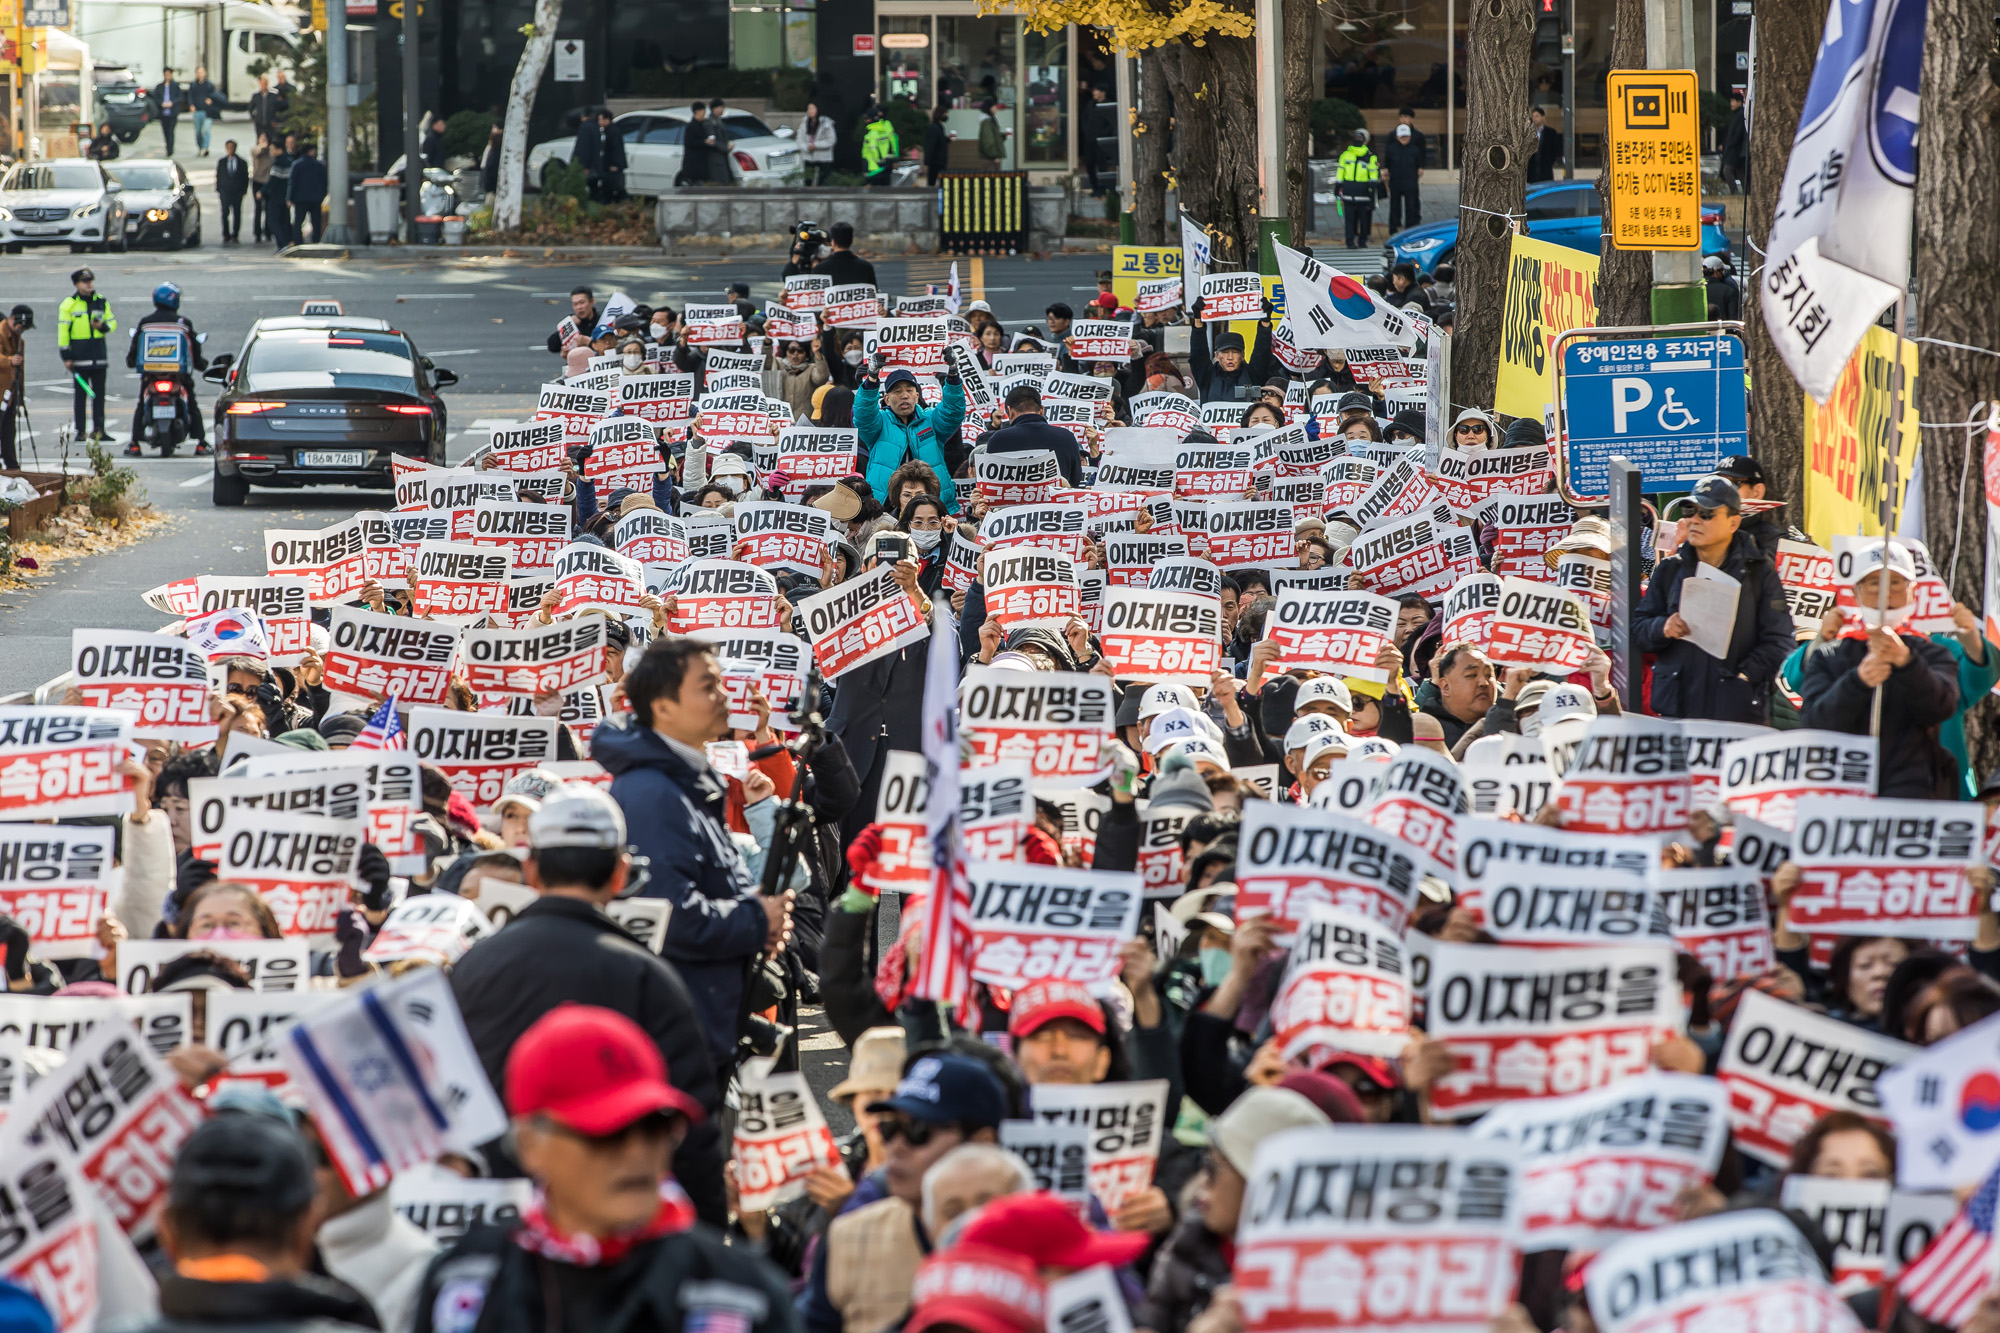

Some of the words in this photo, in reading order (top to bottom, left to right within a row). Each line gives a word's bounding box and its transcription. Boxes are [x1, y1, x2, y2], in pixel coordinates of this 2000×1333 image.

[786, 279, 830, 292] 이재명을
[827, 288, 876, 304] 이재명을
[1202, 277, 1261, 296] 이재명을
[828, 301, 878, 322] 구속하라
[1203, 293, 1262, 317] 구속하라
[879, 325, 947, 343] 이재명을
[1073, 324, 1131, 338] 이재명을
[885, 345, 946, 364] 구속하라
[1072, 339, 1129, 355] 구속하라
[1577, 343, 1659, 363] 장애인전용
[1665, 340, 1732, 358] 주차구역
[1351, 362, 1407, 378] 구속하라
[539, 391, 609, 413] 이재명을
[622, 379, 692, 400] 이재명을
[702, 391, 768, 413] 이재명을
[1047, 379, 1111, 400] 이재명을
[1612, 378, 1653, 433] P
[492, 423, 563, 449] 이재명을
[588, 423, 654, 445] 이재명을
[702, 413, 770, 436] 구속하라
[781, 434, 854, 453] 이재명을
[1279, 440, 1347, 464] 이재명을
[585, 445, 662, 472] 구속하라
[780, 456, 854, 477] 구속하라
[986, 459, 1058, 482] 이재명을
[1176, 451, 1251, 469] 이재명을
[1468, 450, 1550, 475] 이재명을
[1100, 464, 1174, 486] 이재명을
[1176, 472, 1249, 493] 구속하라
[1356, 460, 1415, 526] 이재명을
[477, 510, 567, 535] 이재명을
[738, 509, 826, 537] 이재명을
[989, 511, 1084, 538] 이재명을
[1209, 508, 1292, 534] 이재명을
[1501, 502, 1575, 525] 이재명
[616, 515, 685, 548] 이재명을
[271, 526, 363, 565] 이재명을
[742, 535, 825, 564] 구속하라
[1209, 535, 1295, 561] 구속하라
[1354, 520, 1435, 570] 이재명을
[420, 551, 507, 579] 이재명을
[987, 557, 1075, 589] 이재명을
[1363, 542, 1446, 593] 구속하라
[559, 574, 642, 606] 구속하라
[677, 568, 774, 595] 이재명을
[416, 584, 507, 611] 구속하라
[811, 573, 901, 635] 이재명을
[988, 588, 1081, 616] 구속하라
[671, 597, 776, 627] 구속하라
[1108, 601, 1217, 635] 이재명을
[1279, 599, 1392, 631] 이재명을
[334, 621, 455, 662] 이재명을
[472, 623, 601, 662] 이재명을
[820, 600, 918, 668] 구속하라
[1105, 638, 1221, 671] 구속하라
[1274, 630, 1384, 665] 구속하라
[78, 645, 207, 678] 이재명을
[325, 656, 448, 704] 구속하라
[1313, 682, 1337, 697] NA
[967, 685, 1106, 723] 이재명을
[1156, 690, 1180, 704] NA
[1556, 695, 1581, 708] NA
[1165, 720, 1190, 732] NA
[1310, 719, 1333, 733] NA
[415, 727, 548, 761] 이재명을
[1185, 741, 1211, 753] NA
[1321, 734, 1345, 748] NA
[1364, 742, 1388, 754] NA
[1727, 746, 1871, 788] 이재명을
[1801, 816, 1975, 860] 이재명을
[229, 831, 357, 874] 이재명을
[1250, 826, 1414, 896] 이재명을
[1802, 868, 1973, 917] 구속하라
[1443, 965, 1659, 1023] 이재명을
[1438, 1033, 1662, 1098] 구속하라
[1247, 1159, 1512, 1226] 이재명을
[1237, 1242, 1506, 1325] 구속하라
